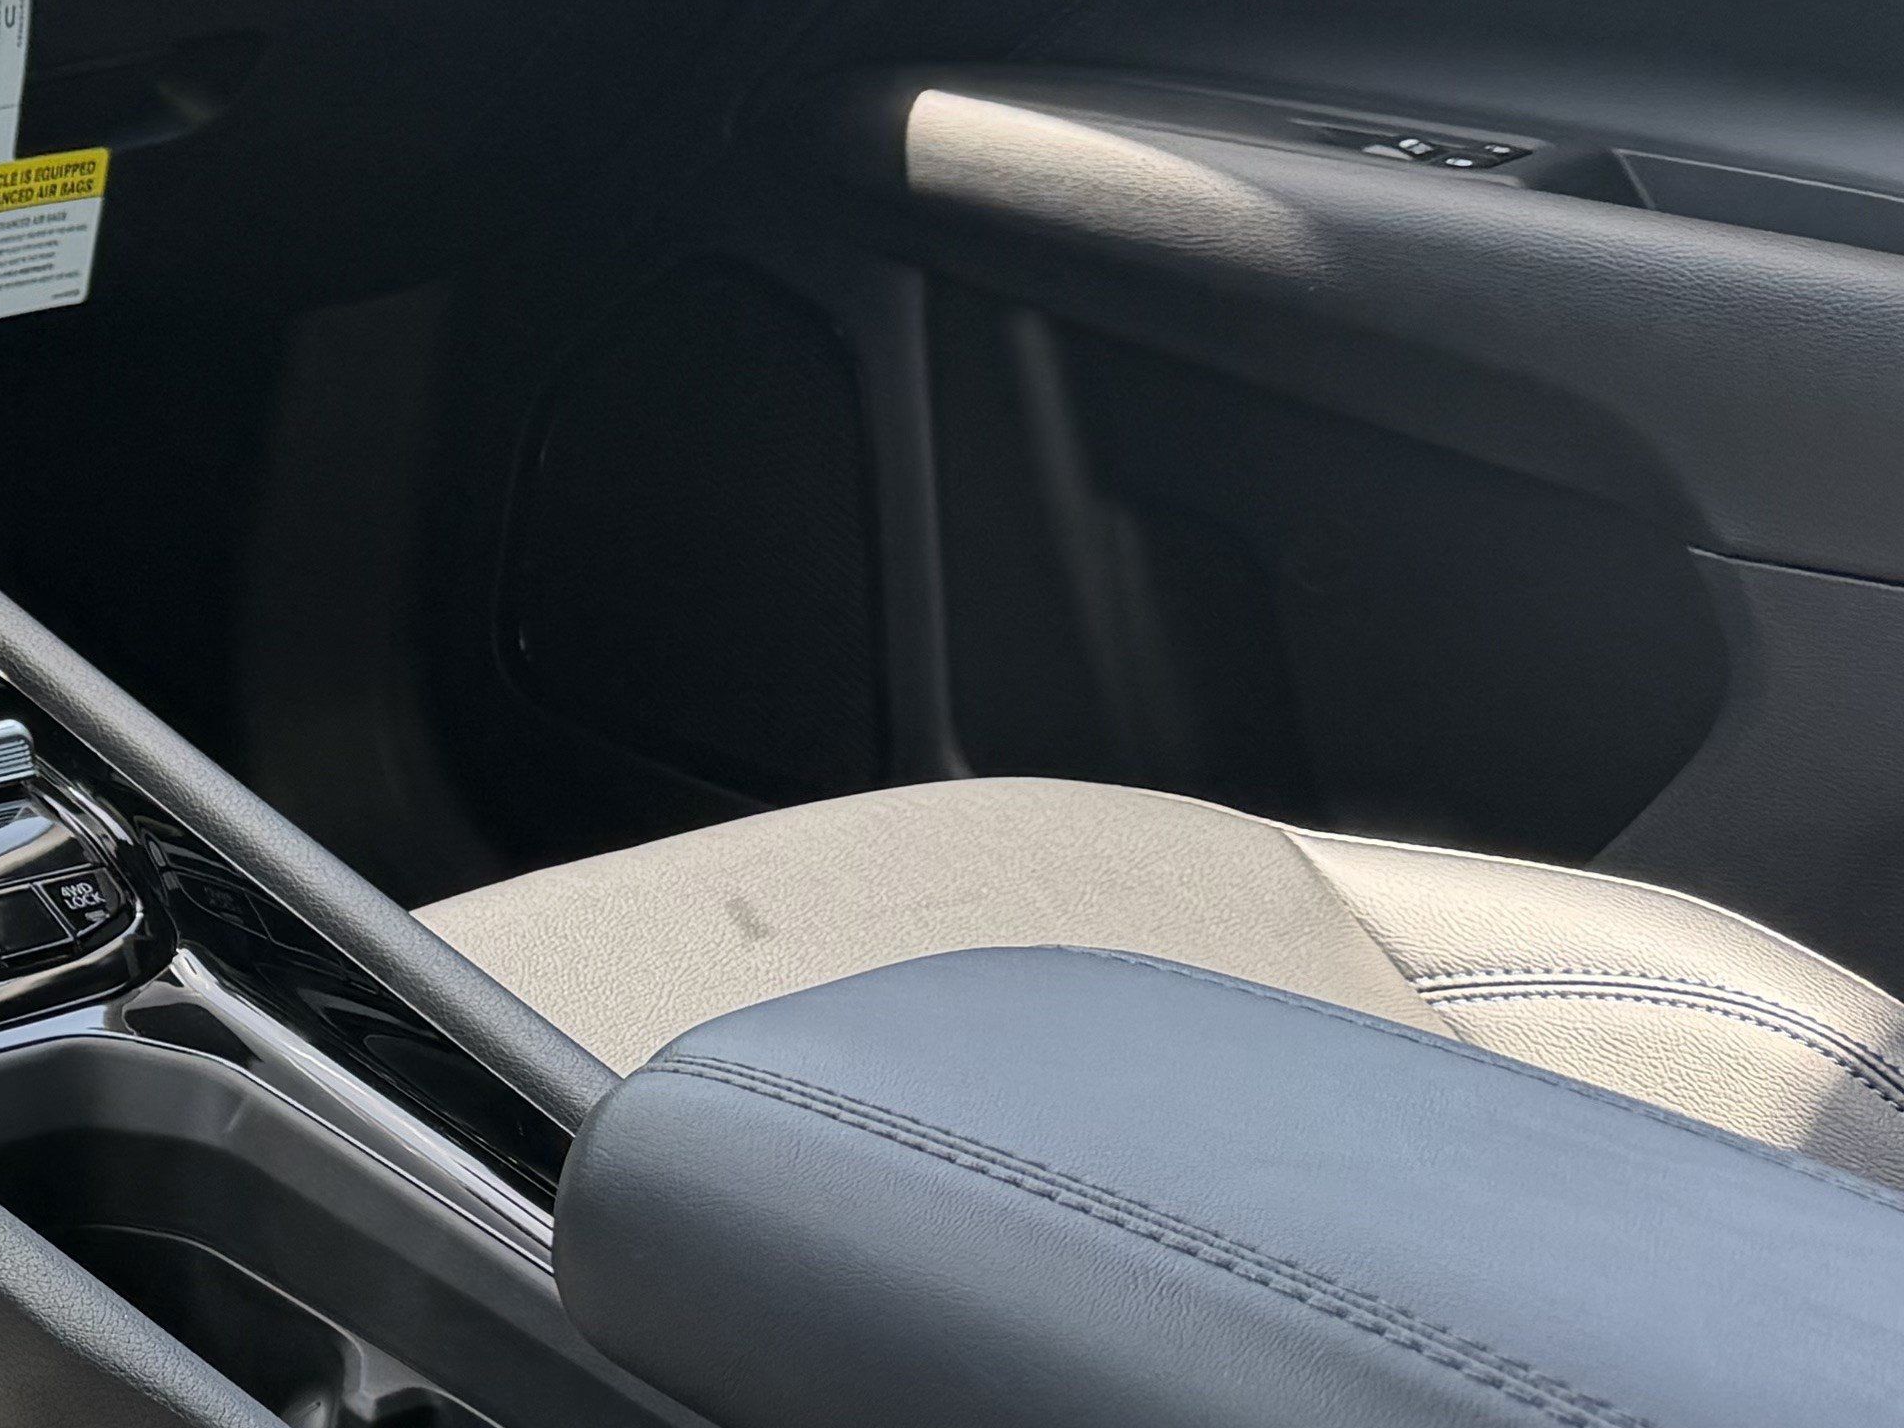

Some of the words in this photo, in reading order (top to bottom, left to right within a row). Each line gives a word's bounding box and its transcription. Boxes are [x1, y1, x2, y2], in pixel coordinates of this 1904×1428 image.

[20, 168, 32, 184] IS
[34, 161, 96, 183] EQUIPPED
[38, 182, 58, 200] AIR
[60, 178, 94, 197] BAGS
[61, 882, 93, 897] 4WD
[64, 892, 107, 910] LOCK
